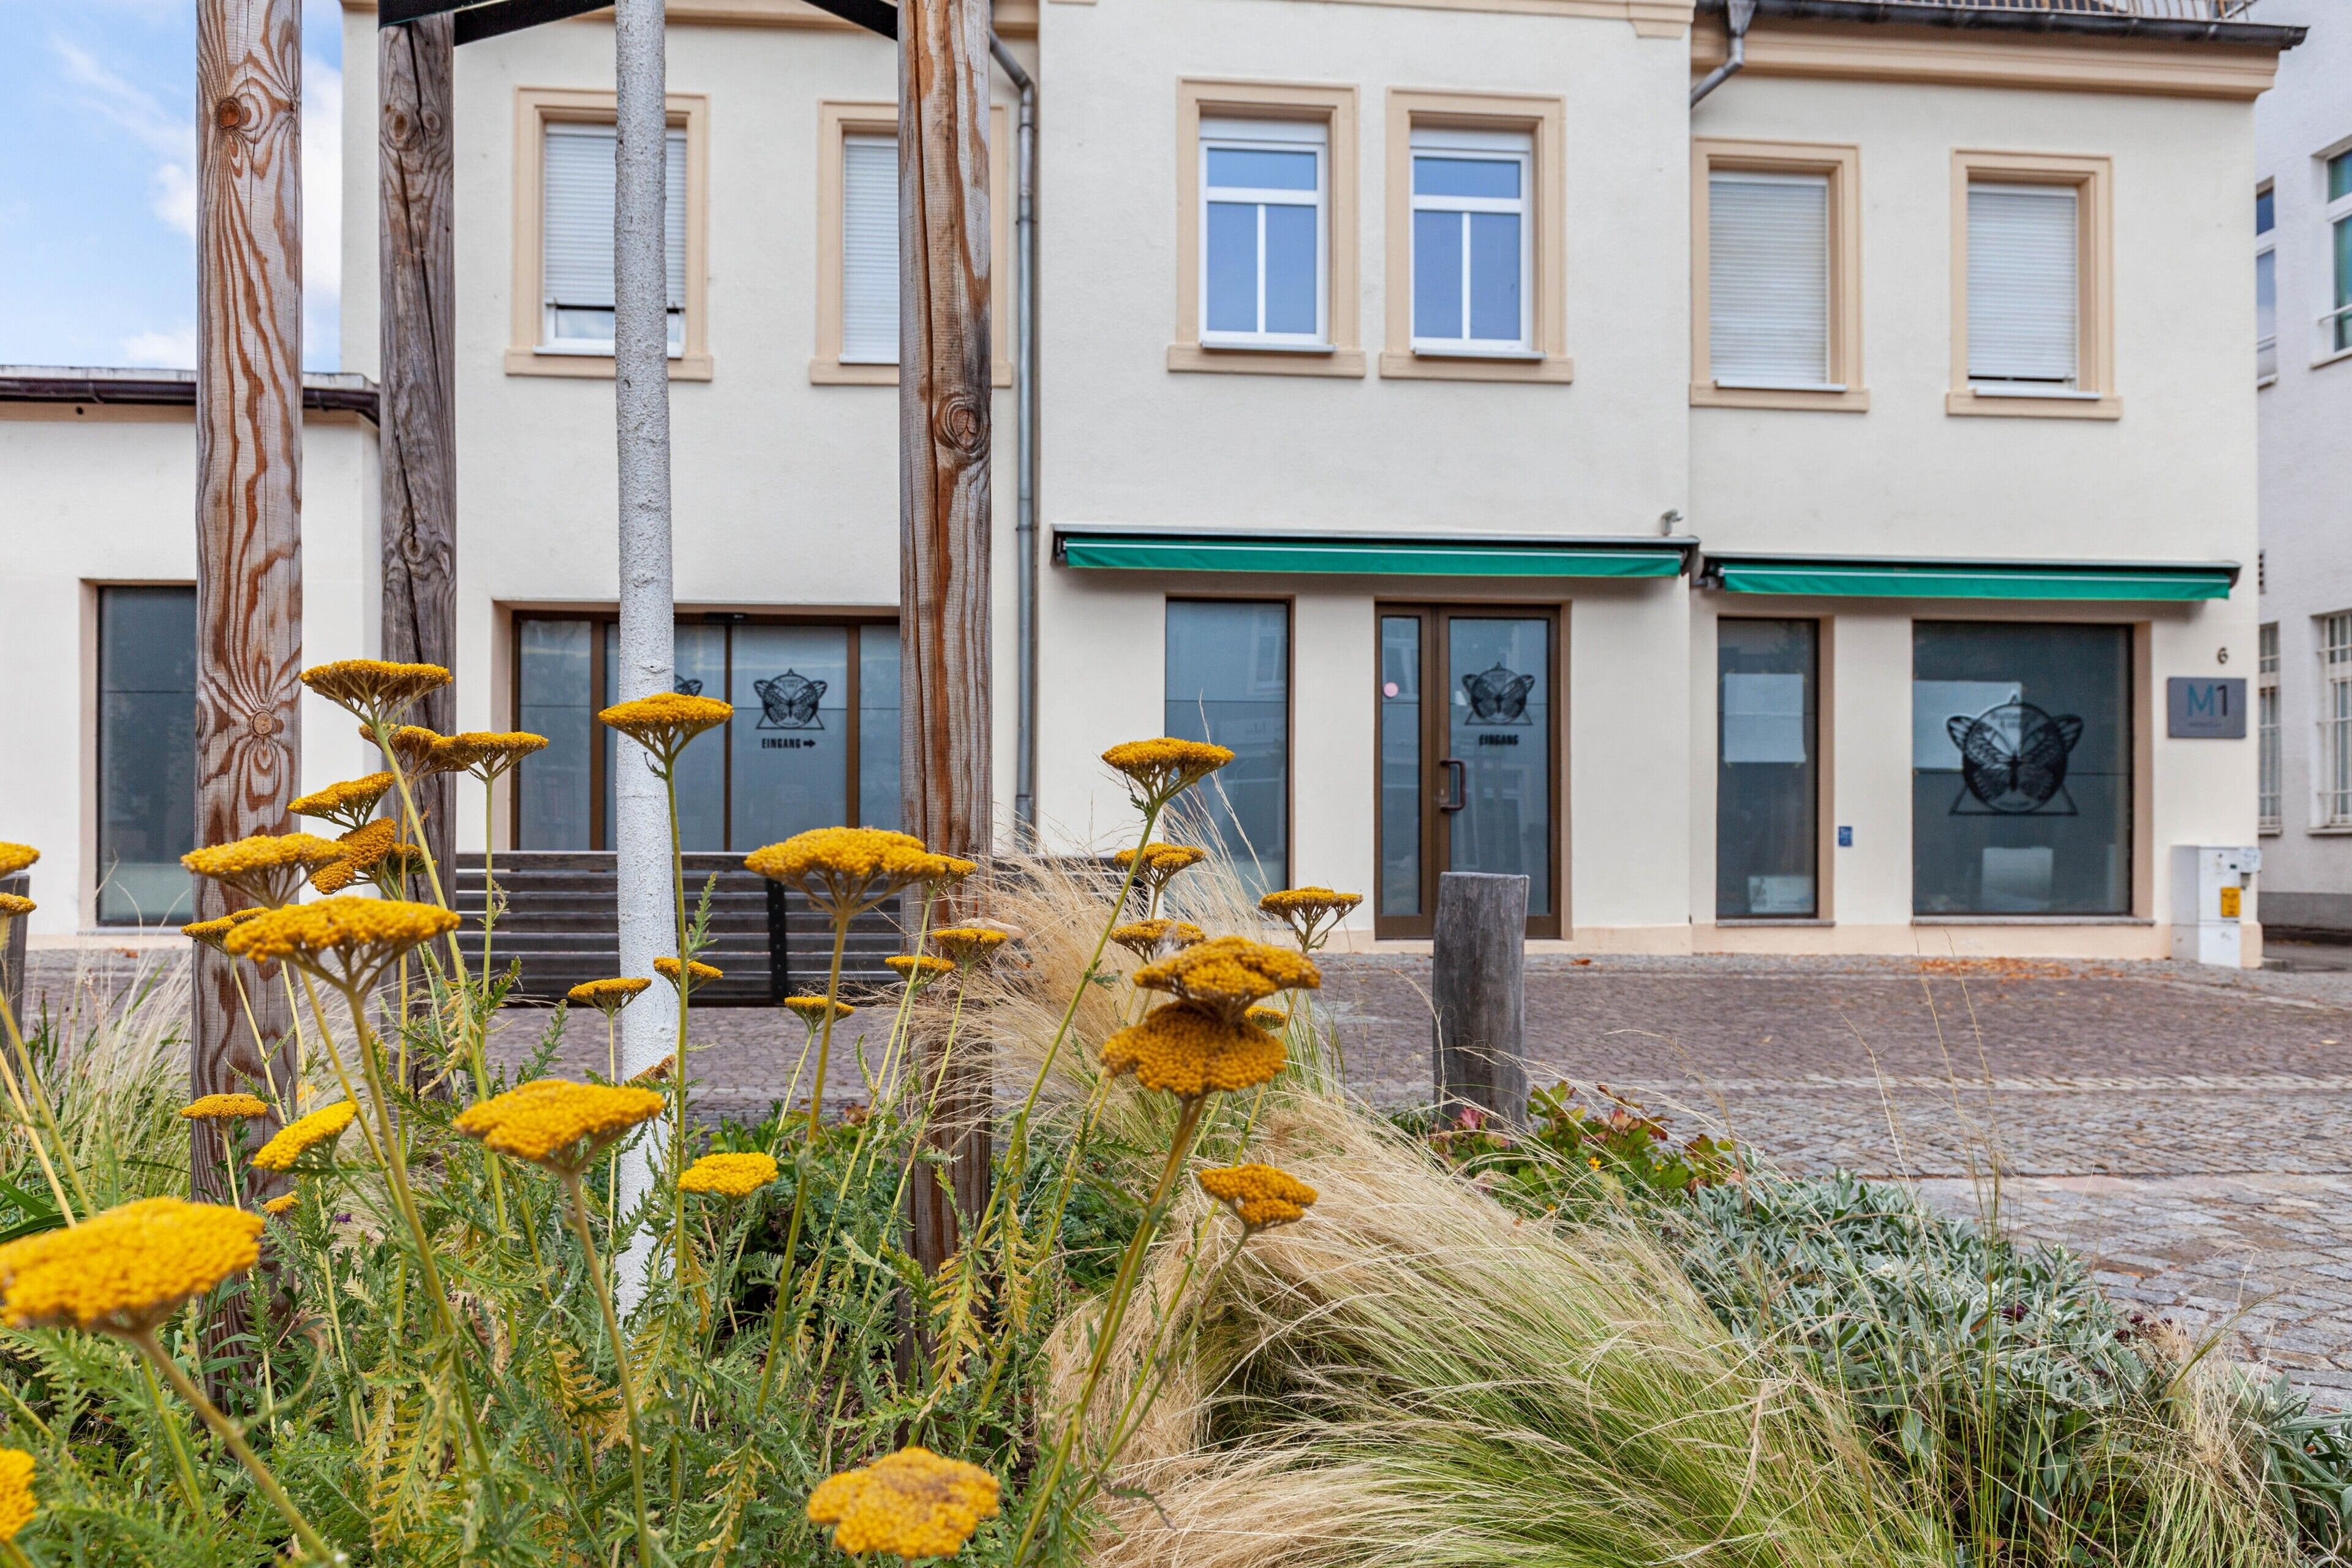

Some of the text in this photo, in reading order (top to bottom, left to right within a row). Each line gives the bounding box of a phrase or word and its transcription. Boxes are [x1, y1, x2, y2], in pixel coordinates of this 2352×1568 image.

[2218, 647, 2228, 665] 6
[2187, 684, 2228, 716] M1
[762, 737, 801, 748] EINGANG
[1479, 734, 1519, 745] EINGANG
